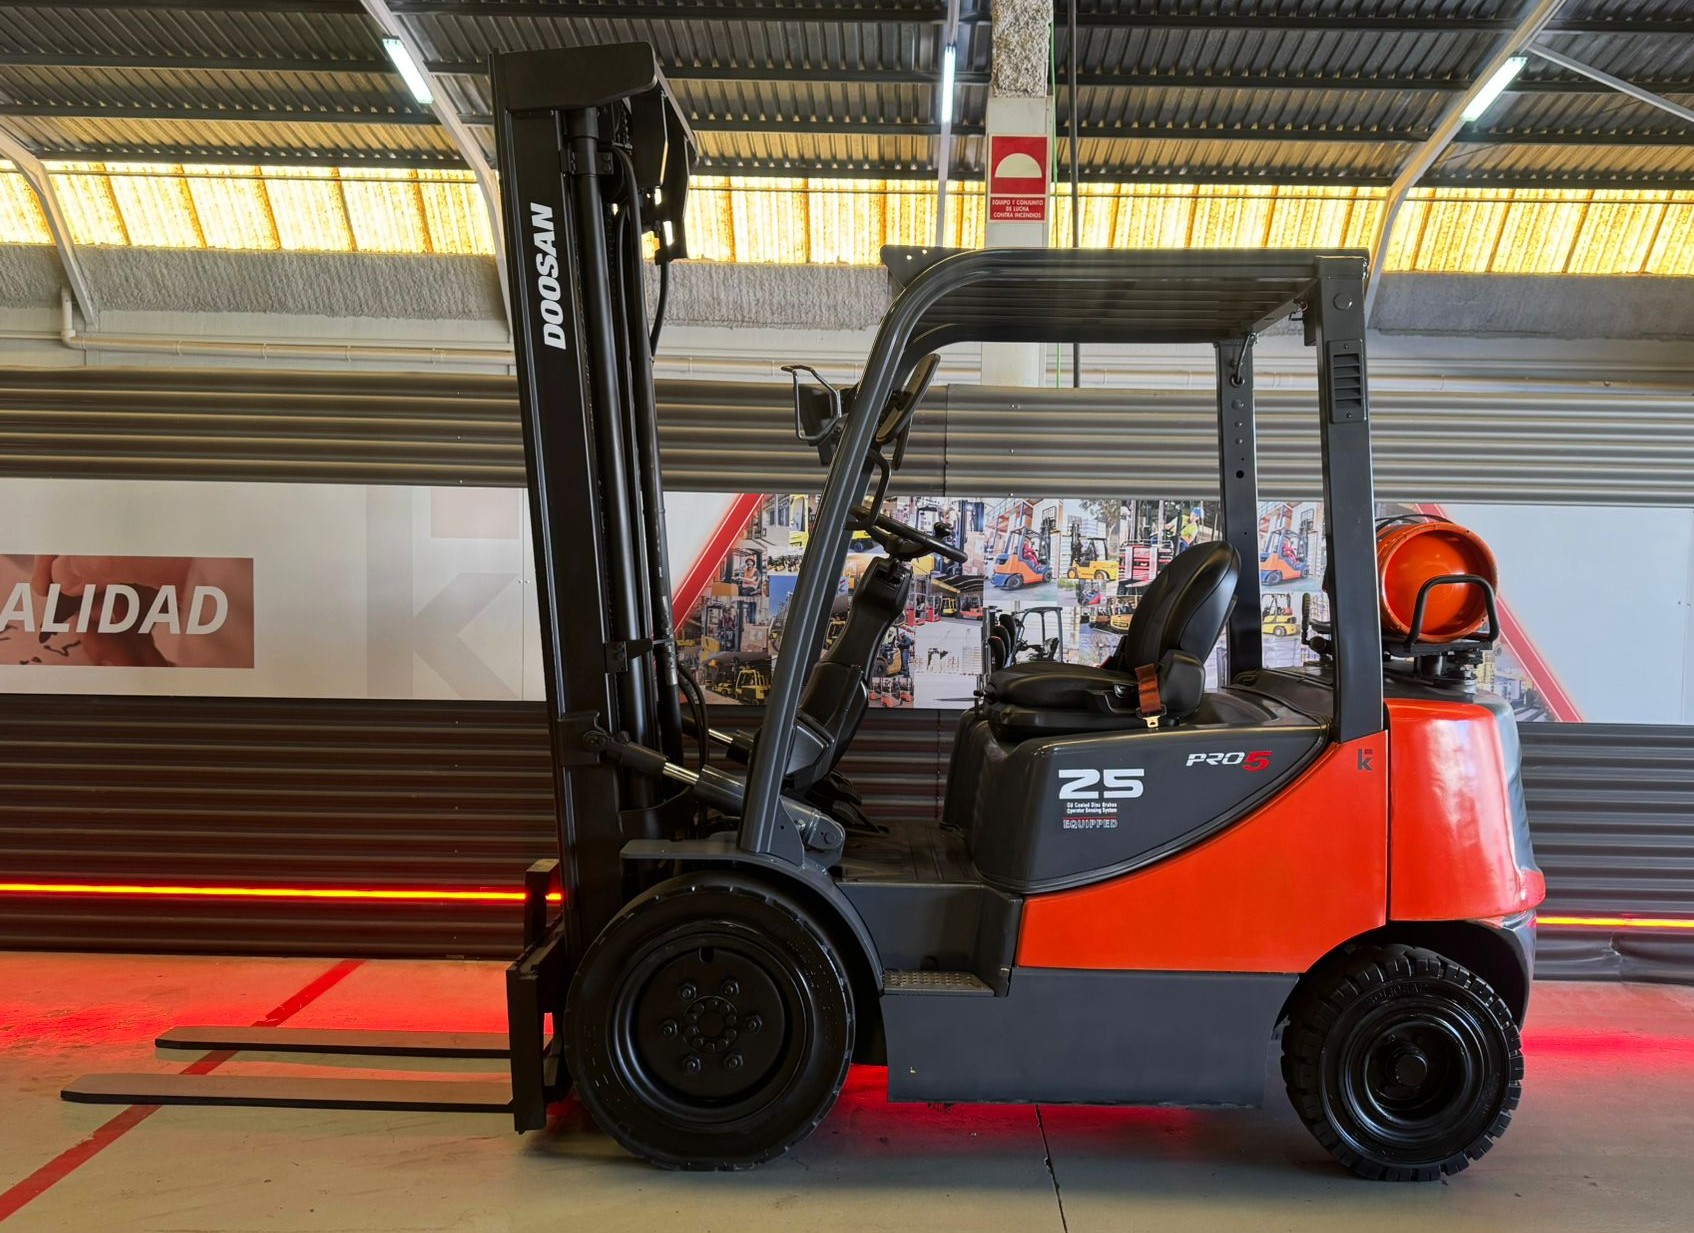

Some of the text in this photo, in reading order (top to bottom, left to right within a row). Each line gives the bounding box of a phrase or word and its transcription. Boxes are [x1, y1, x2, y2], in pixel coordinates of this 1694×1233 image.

[530, 202, 567, 350] DOOSAN
[1058, 768, 1145, 800] 25
[1063, 819, 1119, 829] EQUIPPED
